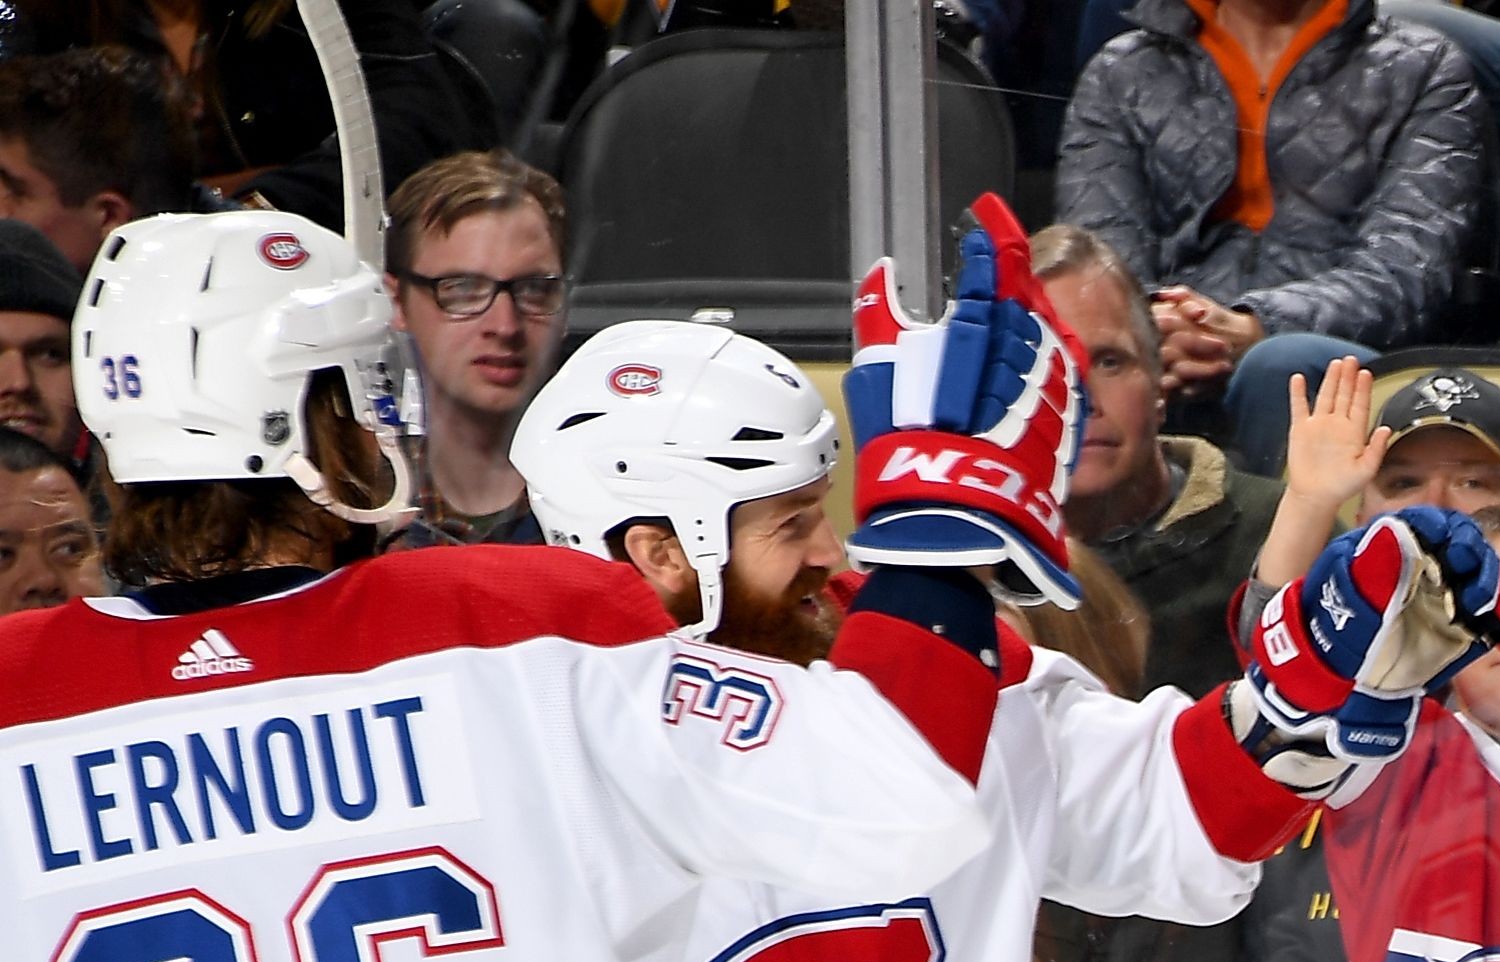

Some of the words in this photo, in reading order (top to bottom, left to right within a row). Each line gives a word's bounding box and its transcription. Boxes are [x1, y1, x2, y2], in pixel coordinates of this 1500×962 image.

[100, 356, 141, 400] 36
[878, 447, 1063, 540] CCM
[171, 657, 255, 680] adidas
[20, 697, 427, 872] LERNOUT
